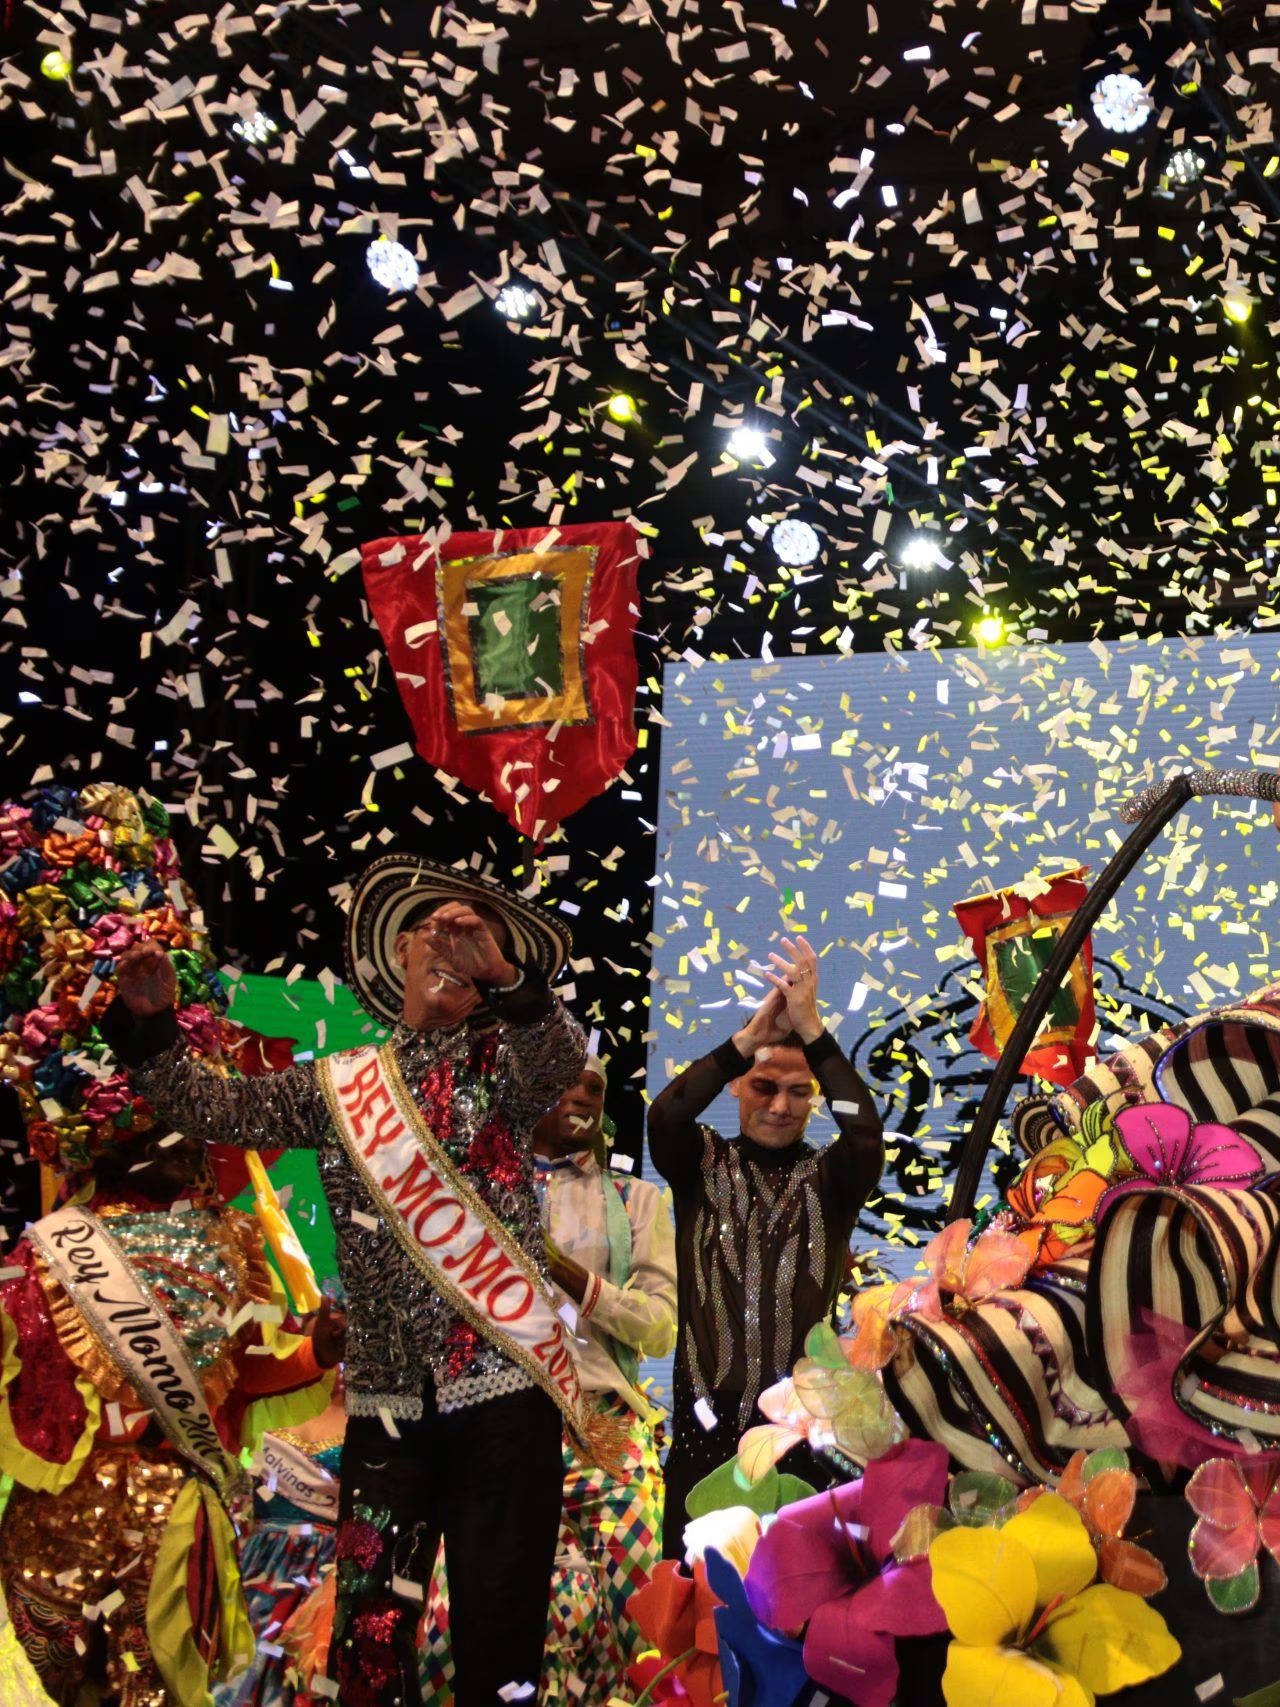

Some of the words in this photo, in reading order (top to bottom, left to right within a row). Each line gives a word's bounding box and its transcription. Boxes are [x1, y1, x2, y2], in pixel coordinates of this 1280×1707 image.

[338, 1058, 405, 1159] REY
[382, 1150, 534, 1322] MOMO
[50, 1219, 109, 1286] Rey
[93, 1288, 195, 1414] Momo
